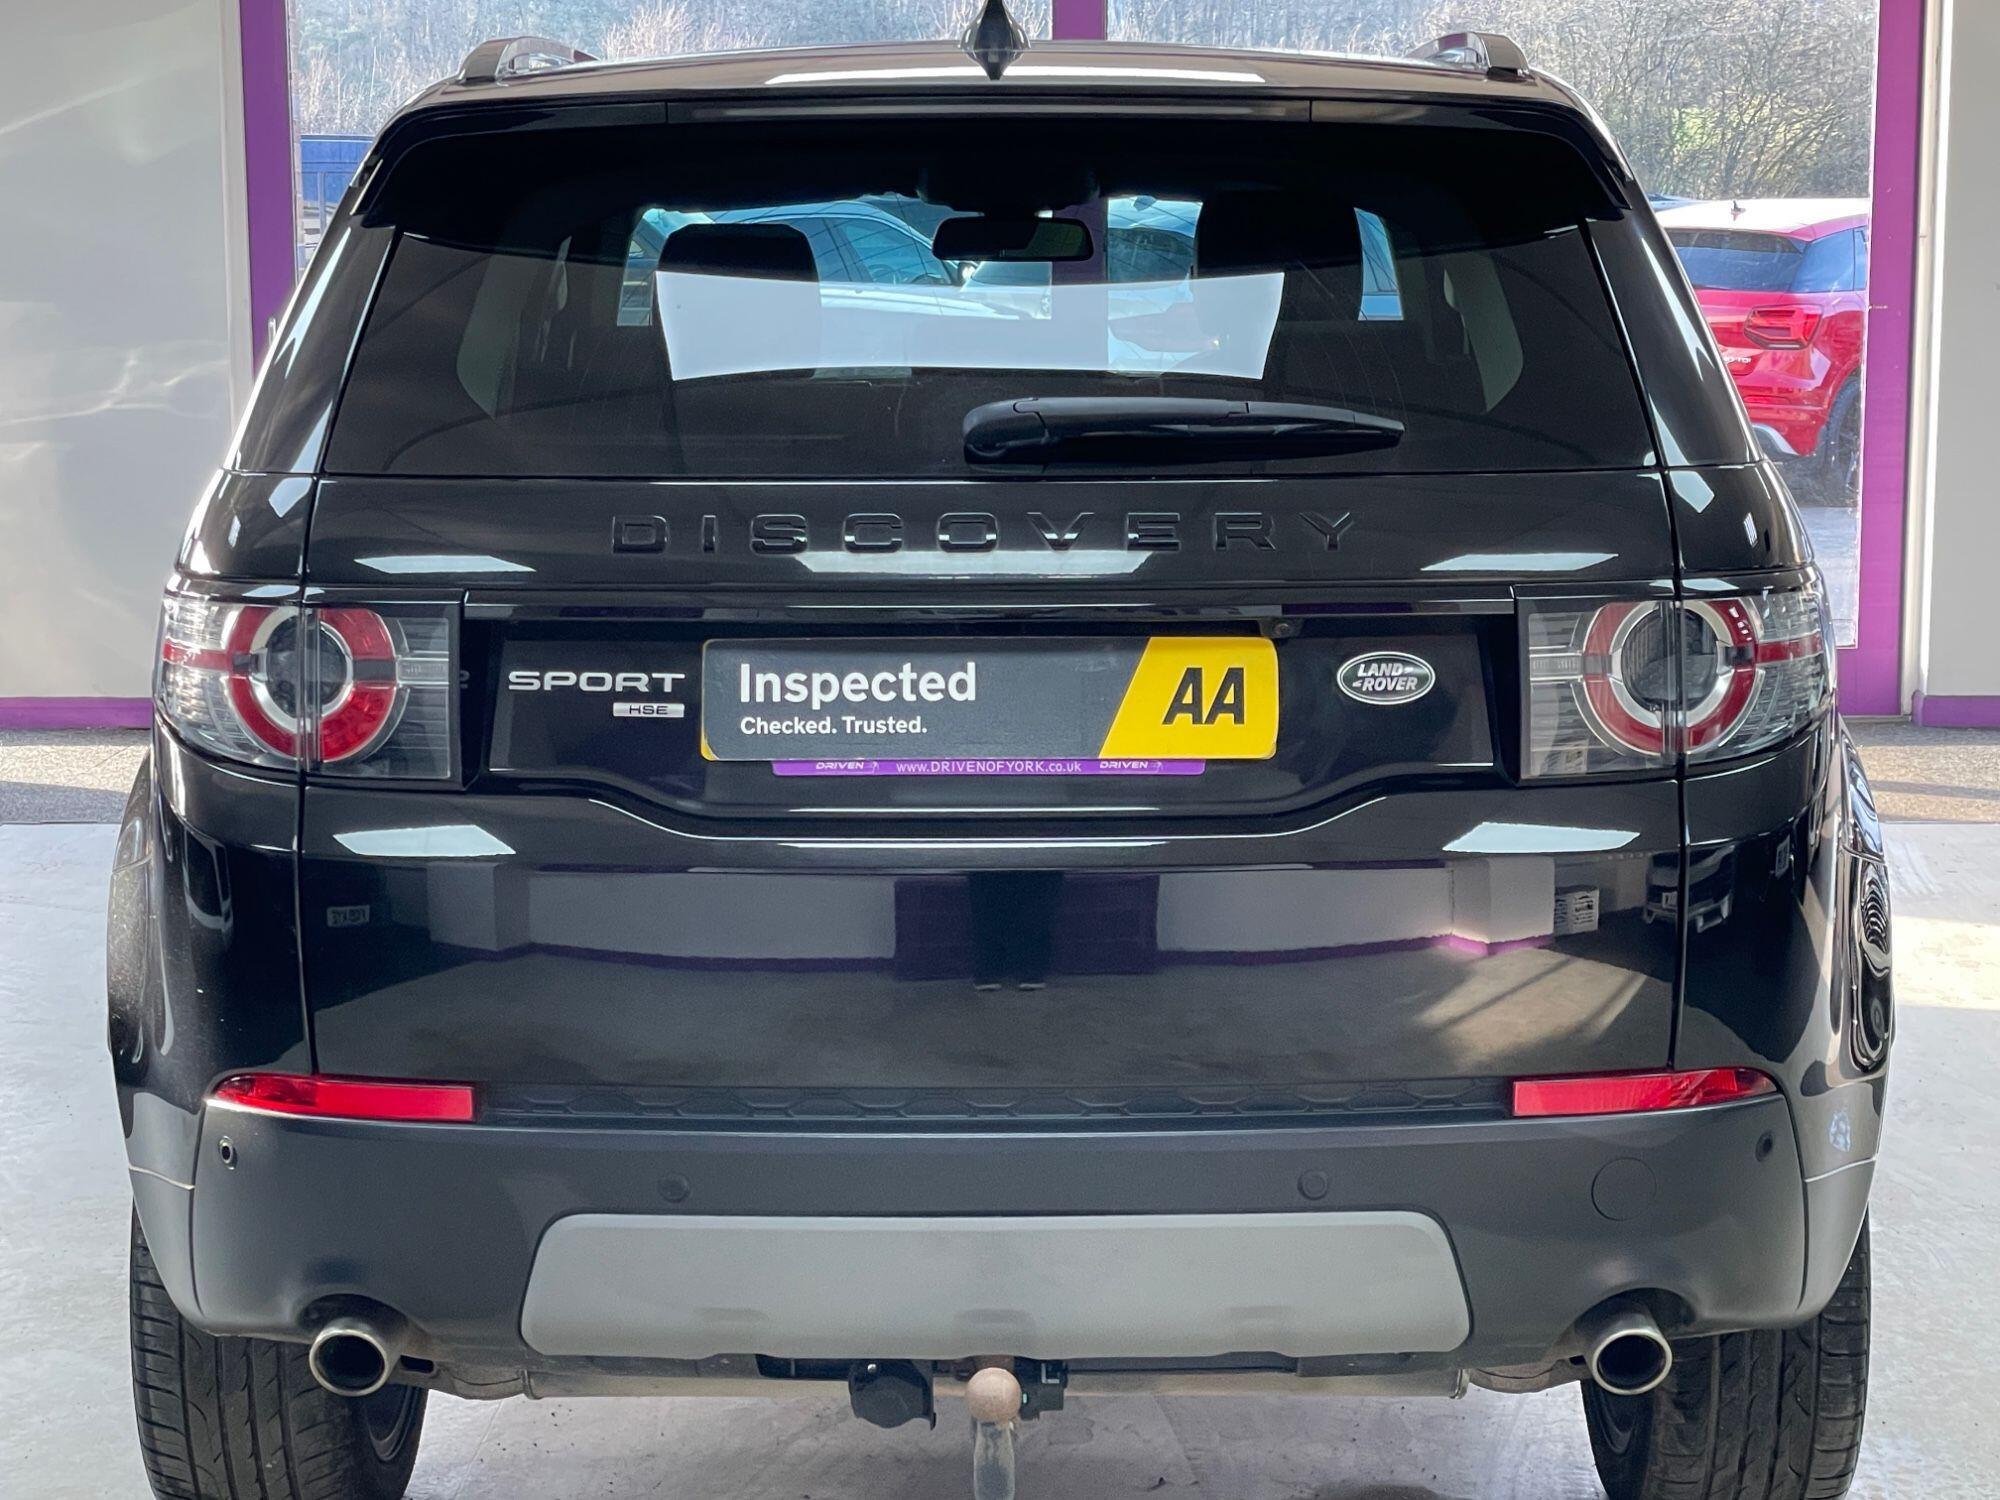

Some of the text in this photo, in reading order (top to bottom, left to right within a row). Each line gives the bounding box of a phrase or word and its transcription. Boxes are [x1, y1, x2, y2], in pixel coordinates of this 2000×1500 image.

[611, 511, 1354, 555] DISCOVERY
[1357, 662, 1403, 678] LAND
[508, 671, 686, 693] SPORT
[740, 661, 977, 710] Inspected
[1362, 676, 1418, 692] ROVER
[1162, 666, 1246, 726] AA
[628, 704, 669, 716] HSE
[740, 716, 928, 735] Checked. Trusted.
[815, 761, 864, 770] DRIVEN
[896, 760, 1082, 774] www.DRIVENOFYORK.co.uk
[1099, 760, 1148, 769] DRIVEN
